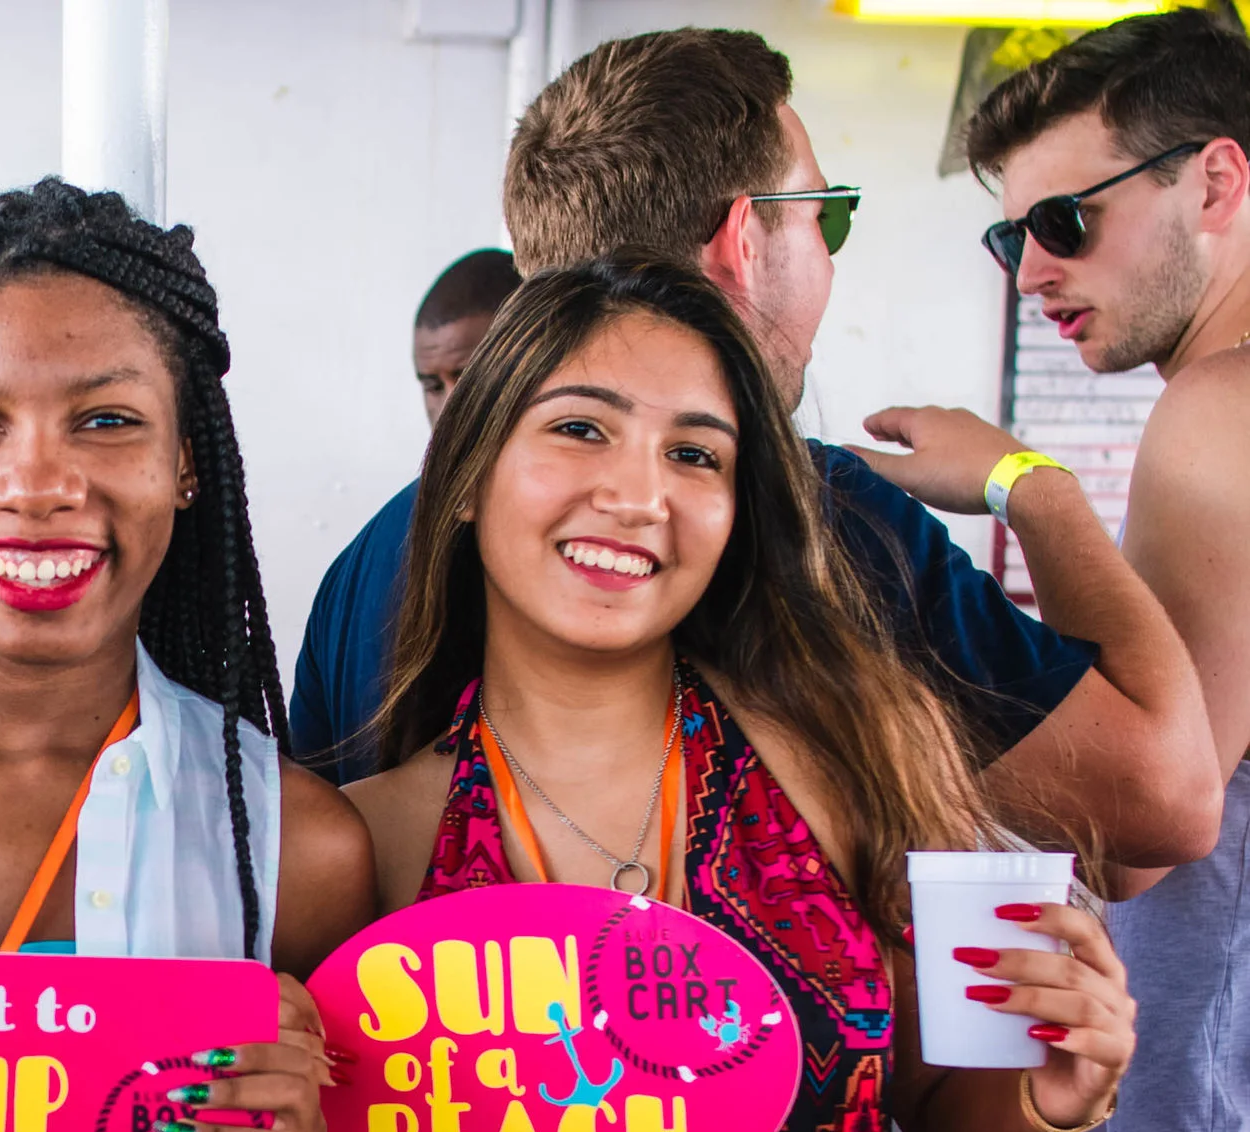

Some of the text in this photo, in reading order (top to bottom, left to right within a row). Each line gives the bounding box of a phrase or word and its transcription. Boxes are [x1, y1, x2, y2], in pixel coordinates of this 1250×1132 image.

[625, 942, 702, 980] BOX
[35, 986, 97, 1034] to
[356, 934, 582, 1042] SUN
[628, 979, 738, 1021] CART
[383, 1037, 526, 1106] of a
